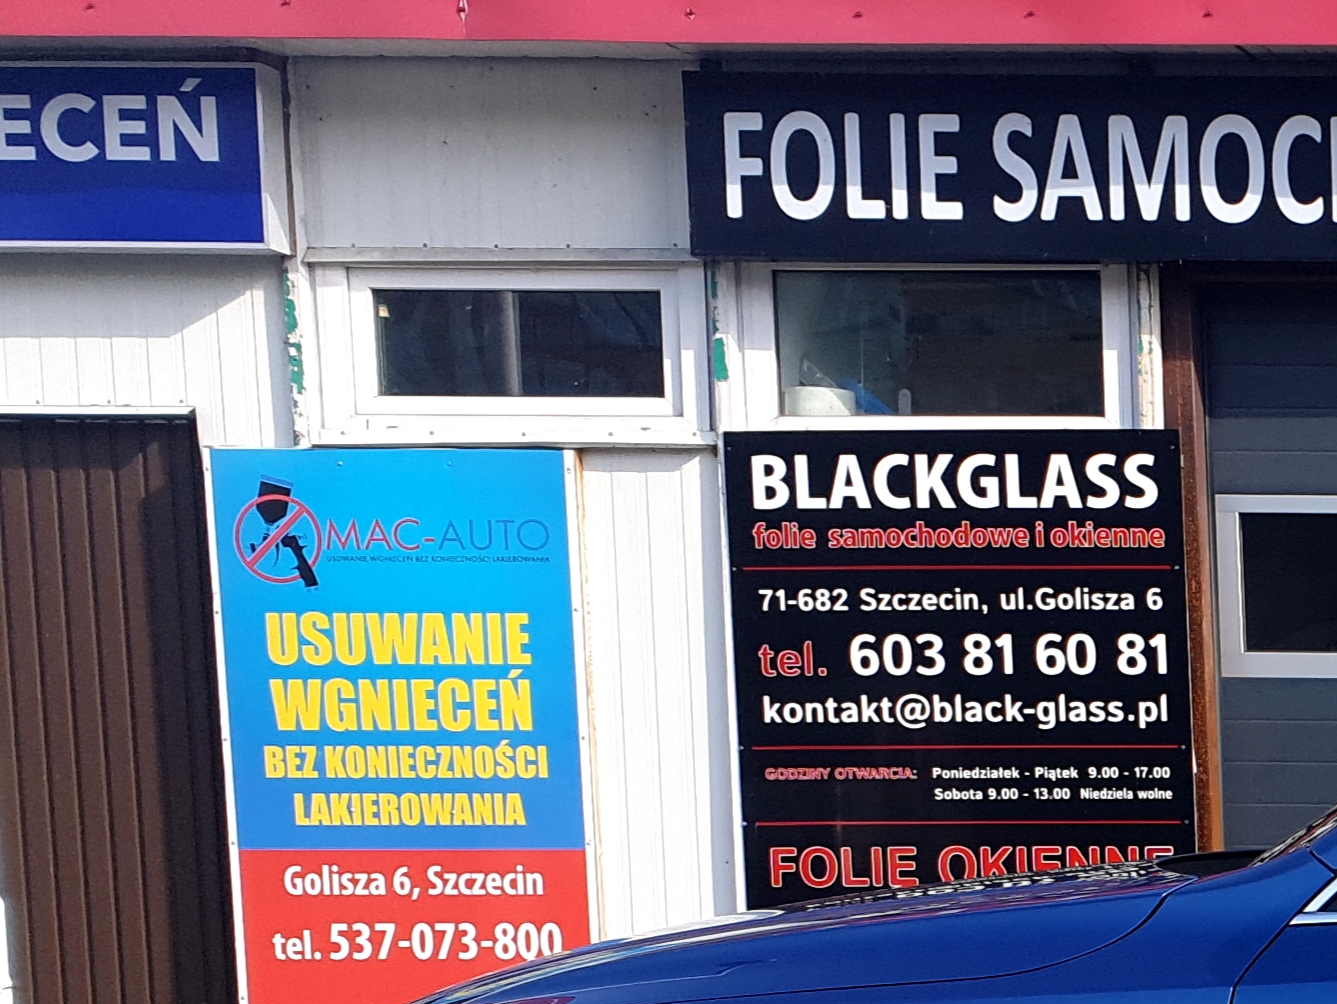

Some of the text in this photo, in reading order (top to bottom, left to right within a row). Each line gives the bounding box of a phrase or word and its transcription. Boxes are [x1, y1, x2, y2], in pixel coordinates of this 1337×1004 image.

[0, 87, 219, 161] ECEŃ
[724, 111, 963, 220] FOLIE
[751, 454, 1158, 509] BLACKGLASS
[325, 518, 550, 550] MAC-AUTO
[752, 521, 1165, 549] folie samochodowe i okienne
[759, 587, 1163, 614] 71-682 Szczecin, ul.Golisza 6
[266, 612, 531, 665] USUWANIE
[758, 633, 1167, 677] tel. 603 81 60 81
[270, 669, 532, 732] WGNIECEŃ
[763, 694, 1167, 729] kontakt@black-glass.pl
[264, 740, 548, 778] BEZ KONIECZNOŚCI
[765, 768, 830, 780] GODZINY
[834, 767, 917, 780] OTWARCIA:
[932, 767, 1020, 778] Poniedziałek
[1035, 767, 1078, 781] Piątek
[1088, 767, 1119, 778] 9.00
[1135, 767, 1170, 778] 17.00
[294, 793, 526, 826] LAKIEROWANIA
[935, 788, 983, 800] Sobota
[988, 788, 1018, 799] 9.00
[1034, 788, 1070, 799] 13.00
[1080, 788, 1133, 799] Niedziela
[1137, 788, 1172, 799] wolne
[284, 865, 543, 900] Golisza 6, Szczecin
[770, 846, 919, 889] FOLIE
[272, 922, 563, 962] tel. 537-073-800
